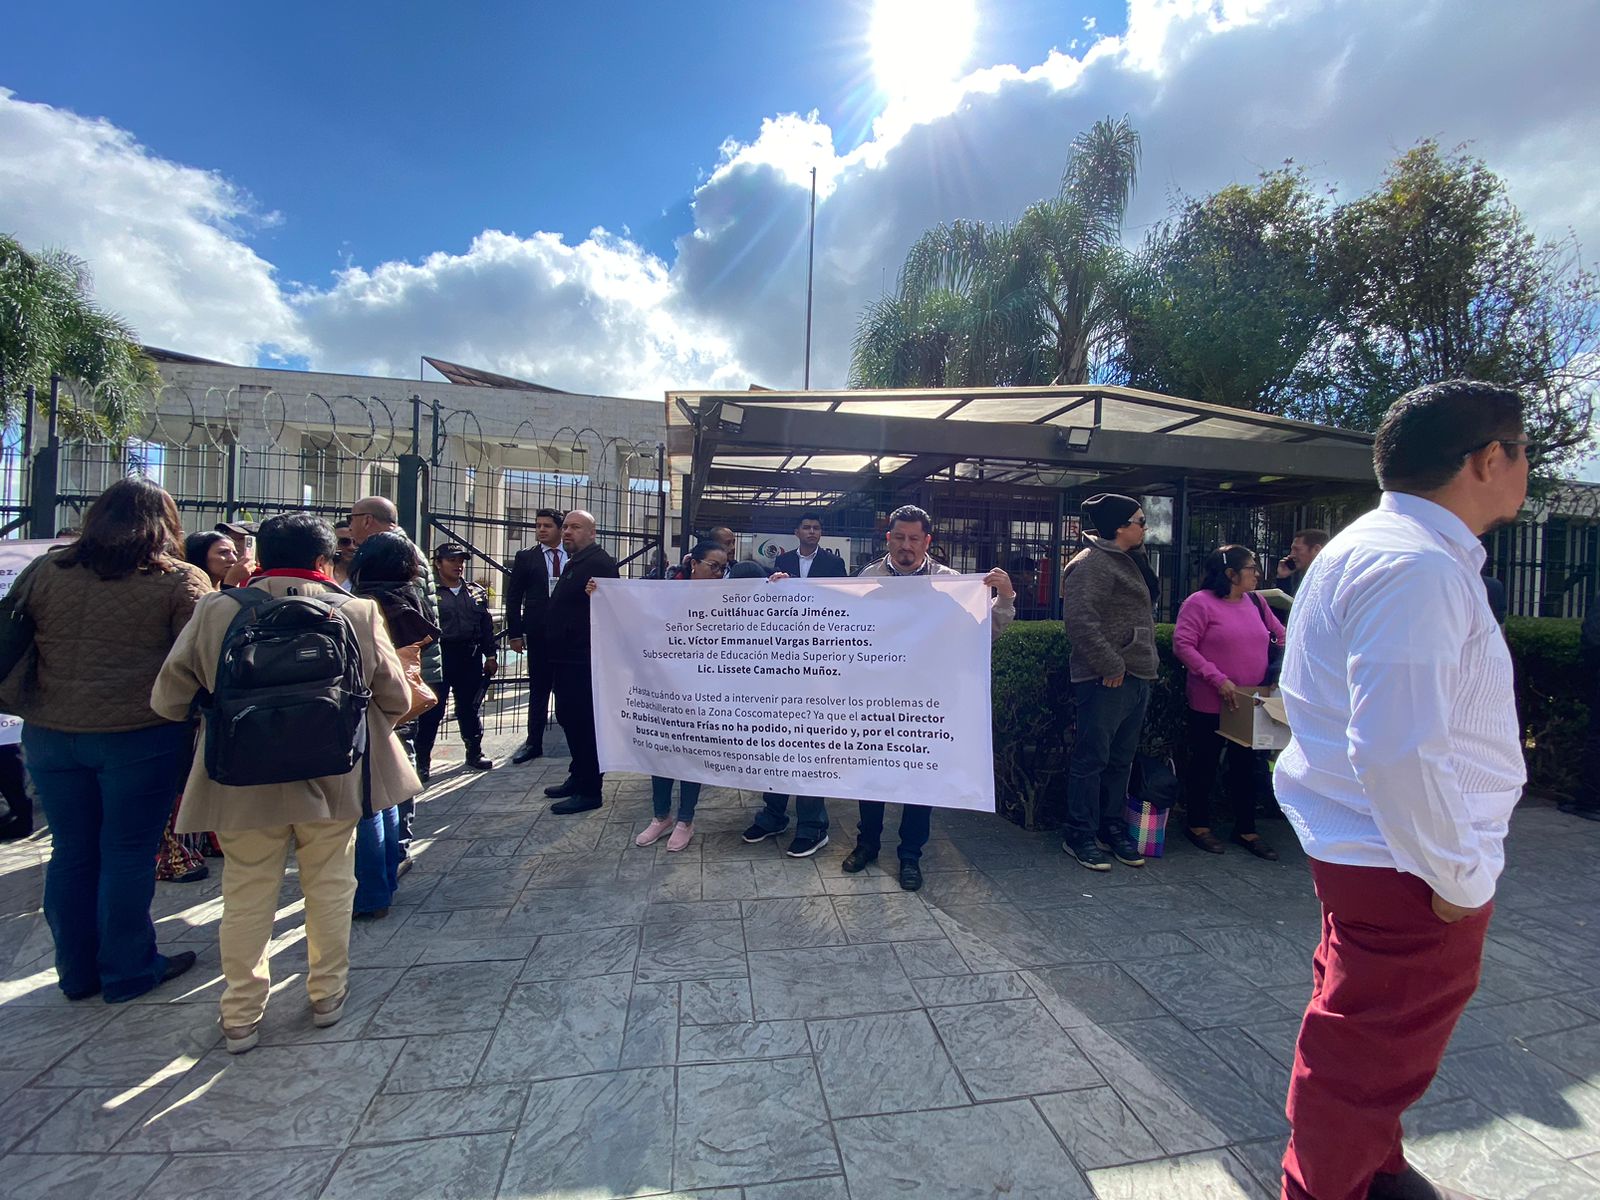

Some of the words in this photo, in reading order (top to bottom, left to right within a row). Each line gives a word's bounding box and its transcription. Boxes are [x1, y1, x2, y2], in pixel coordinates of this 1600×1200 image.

[722, 594, 751, 603] Señor
[753, 593, 814, 603] Gobernador:
[688, 609, 708, 619] Ing.
[711, 608, 764, 617] Cuitláhuac
[767, 607, 798, 617] García
[802, 608, 850, 617] Jiménez.
[666, 623, 693, 631] Señor
[696, 622, 744, 631] Secretario
[747, 622, 758, 631] de
[760, 622, 810, 631] Educación
[813, 623, 825, 631] de
[828, 623, 875, 631] Veracruz:
[668, 636, 686, 645] Lic.
[688, 636, 718, 645] Víctor
[721, 636, 773, 646] Emmanuel
[775, 637, 809, 647] Vargas
[812, 638, 872, 646] Barrientos.
[643, 650, 704, 659] Subsecretaria
[707, 651, 718, 659] de
[721, 651, 768, 660] Educación
[771, 651, 800, 660] Media
[803, 652, 846, 663] Superior
[848, 654, 854, 663] y
[857, 652, 906, 663] Superior:
[698, 665, 714, 674] Lic.
[718, 665, 751, 674] Lissete
[754, 666, 800, 675] Camacho
[803, 667, 841, 676] Muñoz.
[628, 686, 650, 697] ¿Hasta
[651, 691, 680, 701] cuándo
[695, 693, 721, 702] Usted
[733, 694, 778, 704] intervenir
[781, 695, 803, 705] para
[806, 696, 846, 705] resolver
[849, 697, 863, 706] los
[866, 697, 923, 708] problemas
[926, 699, 940, 708] de
[698, 707, 705, 716] la
[709, 708, 732, 716] Zona
[735, 708, 811, 720] Coscomatepec?
[814, 711, 824, 720] Ya
[827, 713, 846, 722] que
[849, 712, 858, 721] el
[861, 712, 895, 722] actual
[898, 713, 944, 723] Director
[621, 710, 631, 719] Dr.
[660, 718, 695, 728] Ventura
[697, 721, 719, 730] Frías
[737, 722, 748, 731] ha
[752, 723, 791, 735] podido,
[794, 724, 804, 733] ni
[807, 726, 848, 736] querido
[851, 729, 860, 738] y,
[863, 729, 882, 738] por
[884, 728, 894, 737] el
[898, 729, 954, 741] contrario,
[636, 726, 659, 736] busca
[672, 731, 743, 746] enfrentamiento
[746, 737, 758, 746] de
[761, 738, 775, 747] los
[778, 738, 825, 749] docentes
[828, 741, 841, 750] de
[844, 741, 854, 750] la
[857, 742, 883, 751] Zona
[887, 743, 930, 754] Escolar.
[633, 738, 644, 746] Por
[646, 740, 652, 749] lo
[654, 744, 672, 752] que,
[673, 744, 680, 753] lo
[682, 746, 721, 757] hacemos
[724, 751, 780, 762] responsable
[783, 753, 795, 762] de
[798, 754, 812, 763] los
[815, 754, 900, 768] enfrentamientos
[903, 760, 923, 770] que
[927, 762, 938, 770] se
[704, 761, 736, 772] lleguen
[746, 765, 761, 774] dar
[764, 768, 788, 777] entre
[792, 769, 841, 779] maestros.
